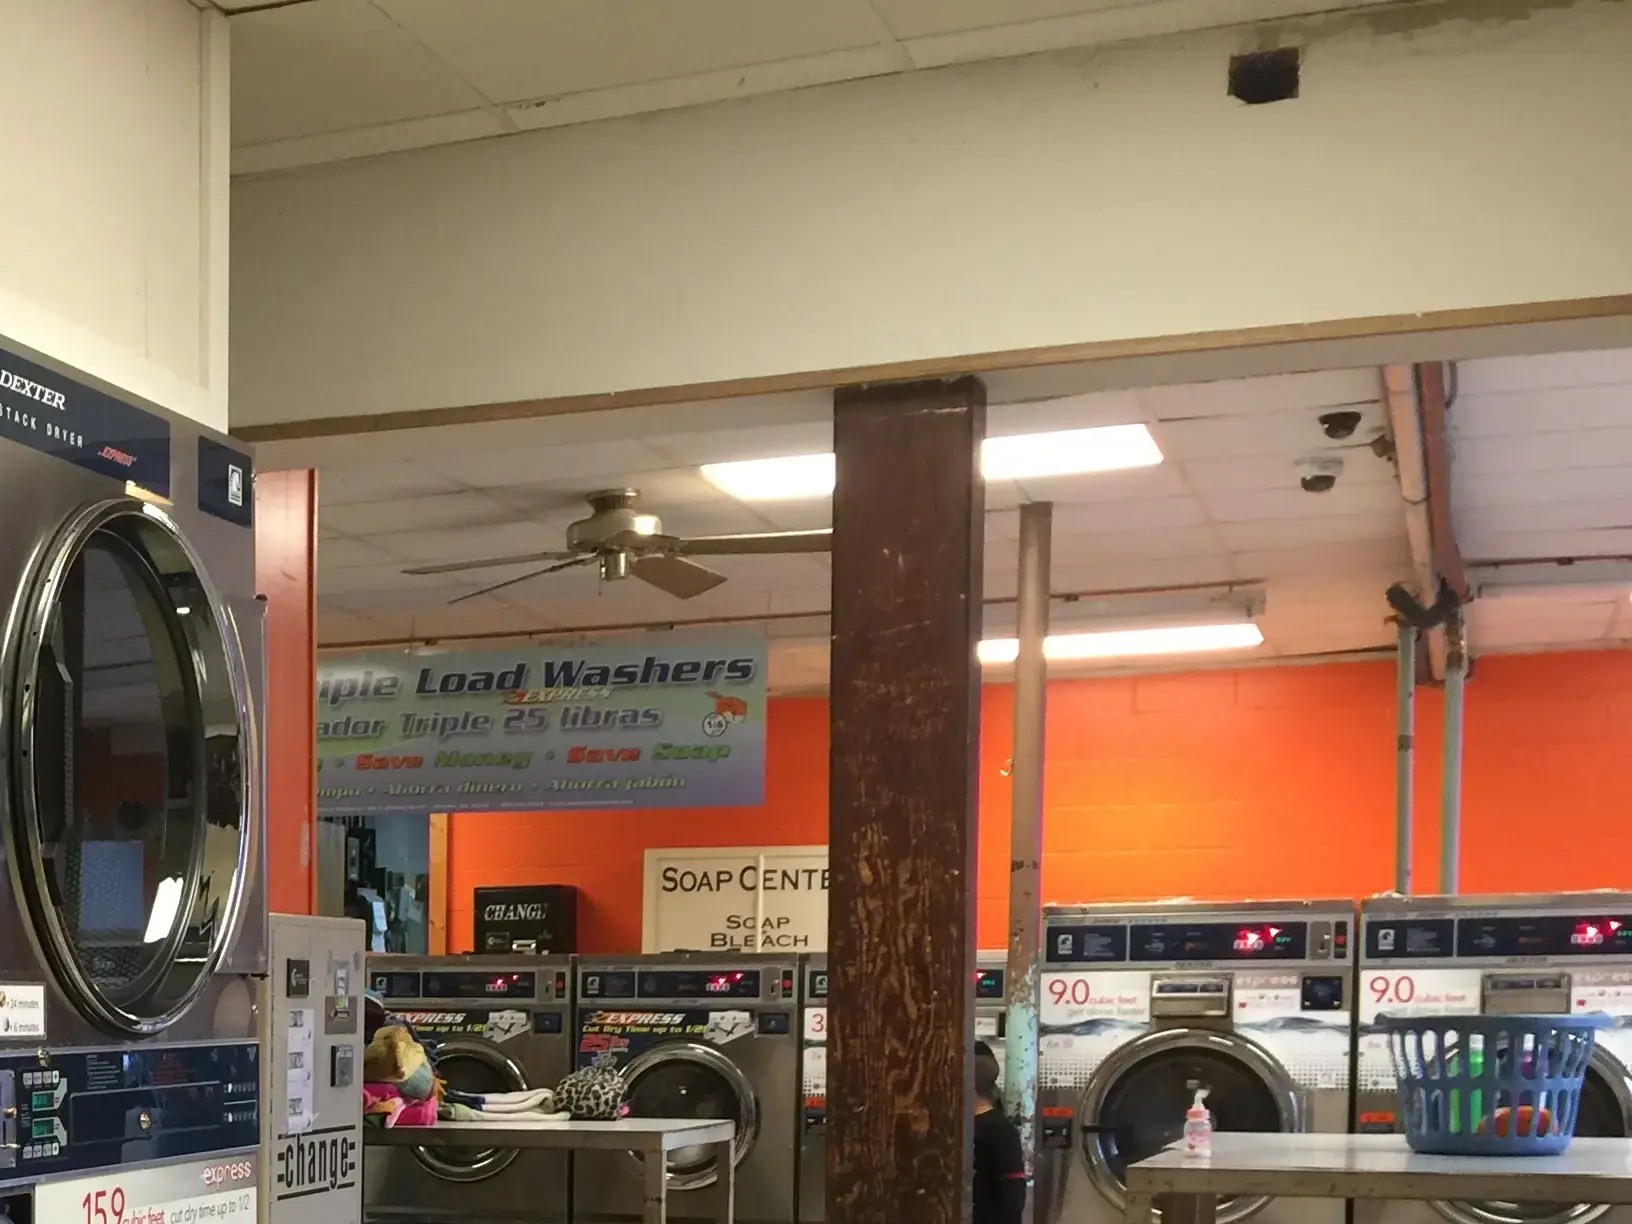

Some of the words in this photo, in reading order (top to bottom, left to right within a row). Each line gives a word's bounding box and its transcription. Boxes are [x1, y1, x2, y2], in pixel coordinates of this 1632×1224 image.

[46, 422, 84, 448] DRYER
[415, 663, 527, 694] Load
[544, 656, 755, 688] Washers
[400, 711, 492, 736] Triple
[503, 708, 549, 730] 25
[561, 706, 660, 728] libras
[355, 754, 424, 770] Save
[435, 751, 532, 769] Money
[567, 745, 641, 763] Save
[653, 743, 731, 761] Soap
[662, 866, 733, 892] SOAP
[710, 932, 808, 948] BLEACH
[1048, 978, 1090, 1005] 9.0
[1369, 976, 1415, 1004] 9.0
[605, 1012, 687, 1025] EXPRESS
[284, 1131, 349, 1190] change
[204, 1161, 252, 1190] express
[170, 1209, 183, 1224] cut
[198, 1202, 216, 1219] time
[217, 1201, 228, 1219] up
[228, 1199, 237, 1213] to
[239, 1193, 250, 1211] 1/2
